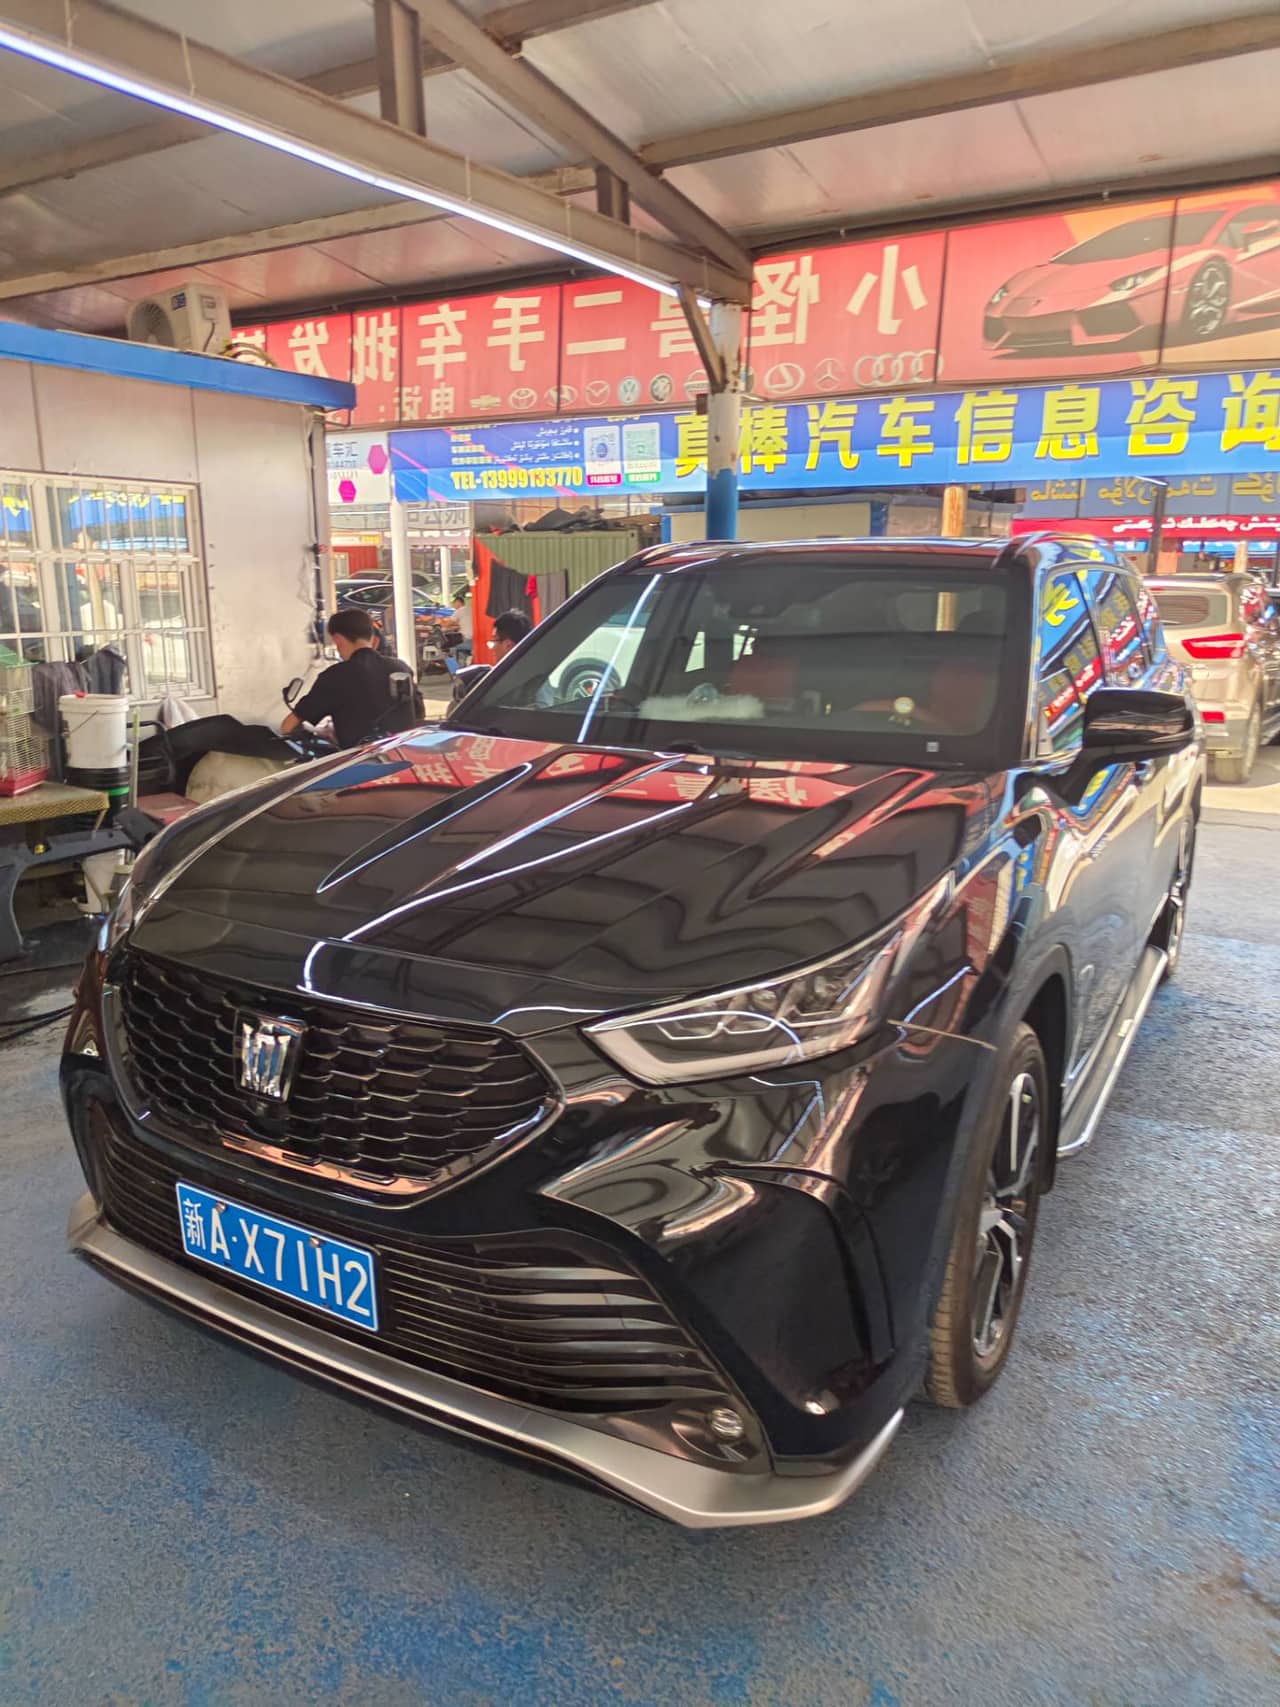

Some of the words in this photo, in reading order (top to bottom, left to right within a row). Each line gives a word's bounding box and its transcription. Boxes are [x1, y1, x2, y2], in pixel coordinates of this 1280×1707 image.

[673, 372, 1280, 477] 真棒汽车信息咨询
